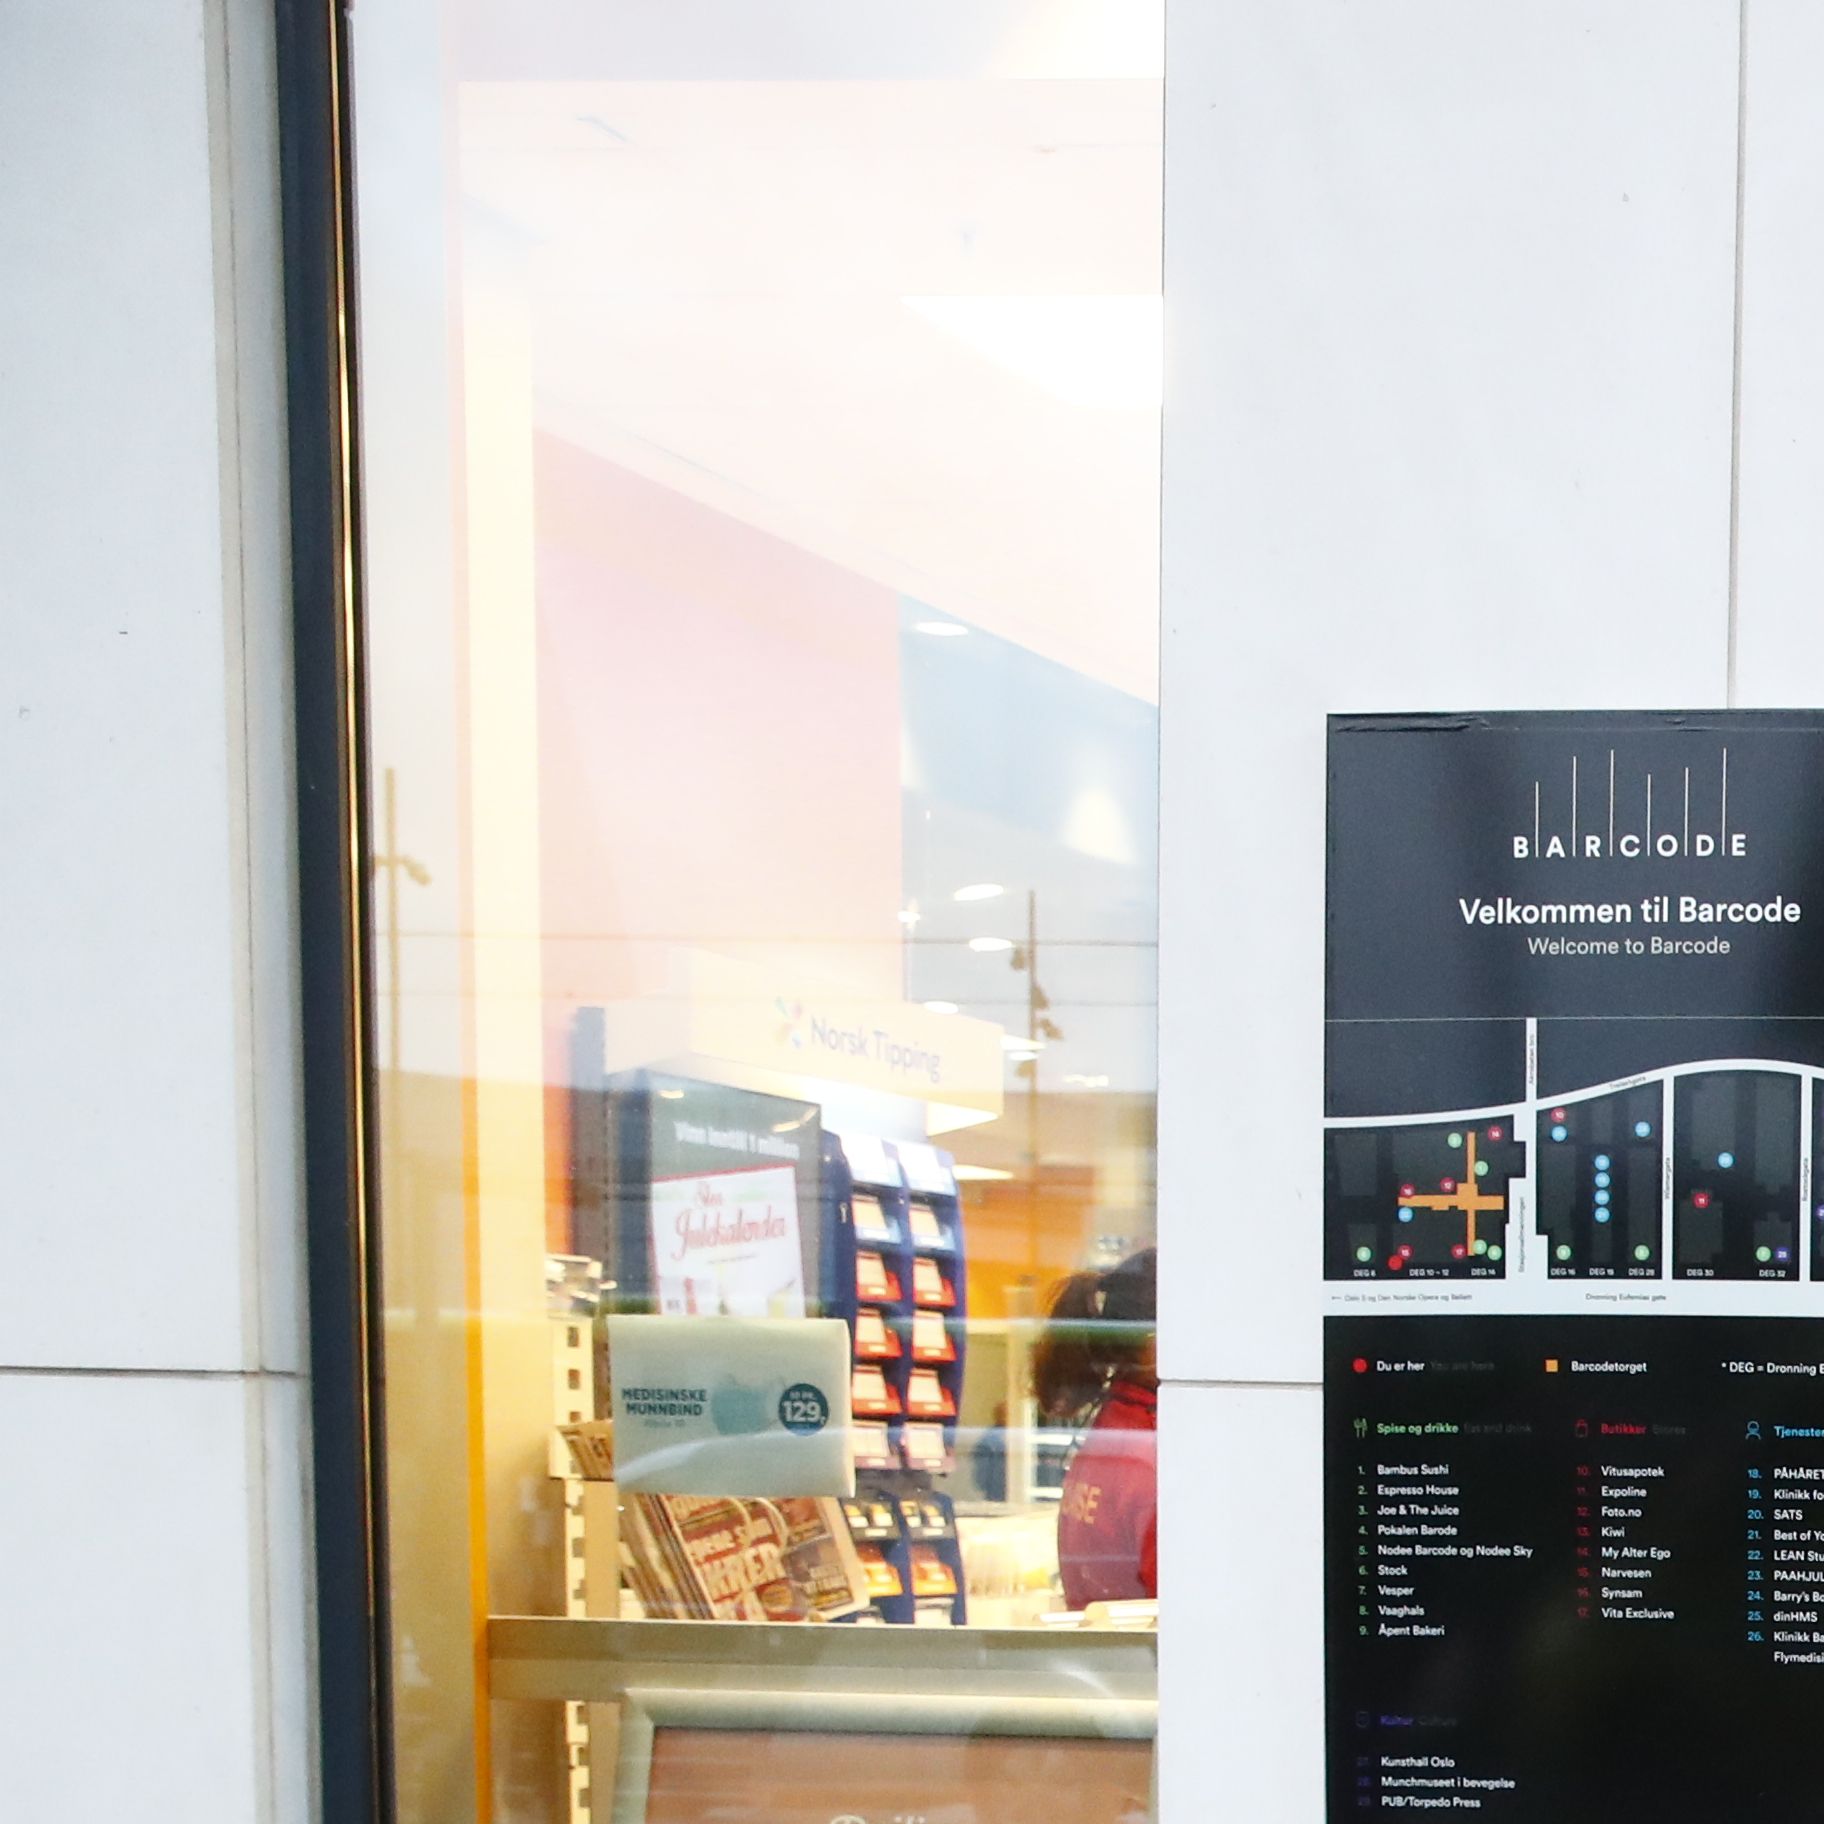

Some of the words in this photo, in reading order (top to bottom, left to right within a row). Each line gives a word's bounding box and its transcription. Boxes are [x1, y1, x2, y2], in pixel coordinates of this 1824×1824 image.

[1459, 898, 1632, 925] Velkommen
[1641, 898, 1669, 924] til
[1678, 897, 1802, 924] Barcode
[1527, 937, 1619, 956] Welcome
[1625, 938, 1644, 955] to
[1651, 937, 1730, 956] Barcode
[811, 1015, 869, 1060] Norsk
[871, 1030, 940, 1082] Tipping
[1377, 1361, 1392, 1371] Du
[1394, 1363, 1405, 1371] er
[1407, 1361, 1424, 1371] her
[1572, 1361, 1647, 1374] Barcodetorget
[1730, 1362, 1754, 1373] DEG
[1767, 1363, 1816, 1376] Dronning
[622, 1388, 708, 1401] MEDISINSKE
[626, 1403, 703, 1416] MUNNBIND
[1377, 1423, 1406, 1435] Spise
[1408, 1426, 1422, 1435] og
[1424, 1423, 1458, 1433] drikke
[1377, 1465, 1418, 1475] Bambus
[1421, 1464, 1448, 1474] Sushi
[1601, 1466, 1664, 1478] Vitusapotek
[1748, 1469, 1761, 1478] 18.
[1378, 1485, 1423, 1496] Espresso
[1426, 1485, 1459, 1495] House
[1602, 1486, 1647, 1498] Expoline
[1748, 1489, 1761, 1499] 19.
[1774, 1489, 1810, 1499] Klinikk
[1377, 1505, 1397, 1515] Joe
[1399, 1505, 1407, 1515] &
[1409, 1504, 1429, 1515] The
[1431, 1505, 1459, 1515] Juice
[1602, 1506, 1642, 1517] Foto.no
[1748, 1510, 1764, 1519] 20.
[1774, 1509, 1802, 1520] SATS
[1378, 1525, 1418, 1535] Pokalen
[1421, 1525, 1457, 1535] Barode
[1602, 1527, 1624, 1537] Kiwi
[1748, 1530, 1761, 1539] 21.
[1774, 1530, 1797, 1540] Best
[1800, 1530, 1811, 1541] of
[1378, 1545, 1412, 1555] Nodee
[1415, 1545, 1457, 1555] Barcode
[1460, 1548, 1473, 1558] og
[1476, 1545, 1511, 1556] Nodee
[1514, 1545, 1533, 1558] Sky
[1602, 1547, 1619, 1559] My
[1622, 1547, 1647, 1557] Alter
[1650, 1547, 1671, 1560] Ego
[1748, 1550, 1763, 1560] 22.
[1774, 1550, 1804, 1560] LEAN
[1378, 1565, 1407, 1575] Stock
[1602, 1567, 1651, 1578] Narvesen
[1748, 1570, 1763, 1580] 23.
[1378, 1585, 1414, 1597] Vesper
[1602, 1587, 1642, 1599] Synsam
[1748, 1591, 1763, 1600] 24.
[1378, 1605, 1424, 1618] Vaaghals
[1602, 1608, 1623, 1618] Vita
[1626, 1608, 1674, 1619] Exclusive
[1748, 1611, 1763, 1621] 25.
[1774, 1611, 1817, 1622] dinHMS
[1379, 1623, 1410, 1637] Åpent
[1413, 1625, 1444, 1635] Bakeri
[1748, 1632, 1764, 1641] 26.
[1774, 1632, 1810, 1642] Klinikk
[1381, 1757, 1428, 1767] Kunsthall
[1431, 1757, 1455, 1767] Oslo
[1381, 1776, 1455, 1787] Munchmuseet
[1463, 1777, 1515, 1790] bevegelse
[1382, 1796, 1451, 1808] PUB/Torpedo
[1453, 1797, 1480, 1807] Press
